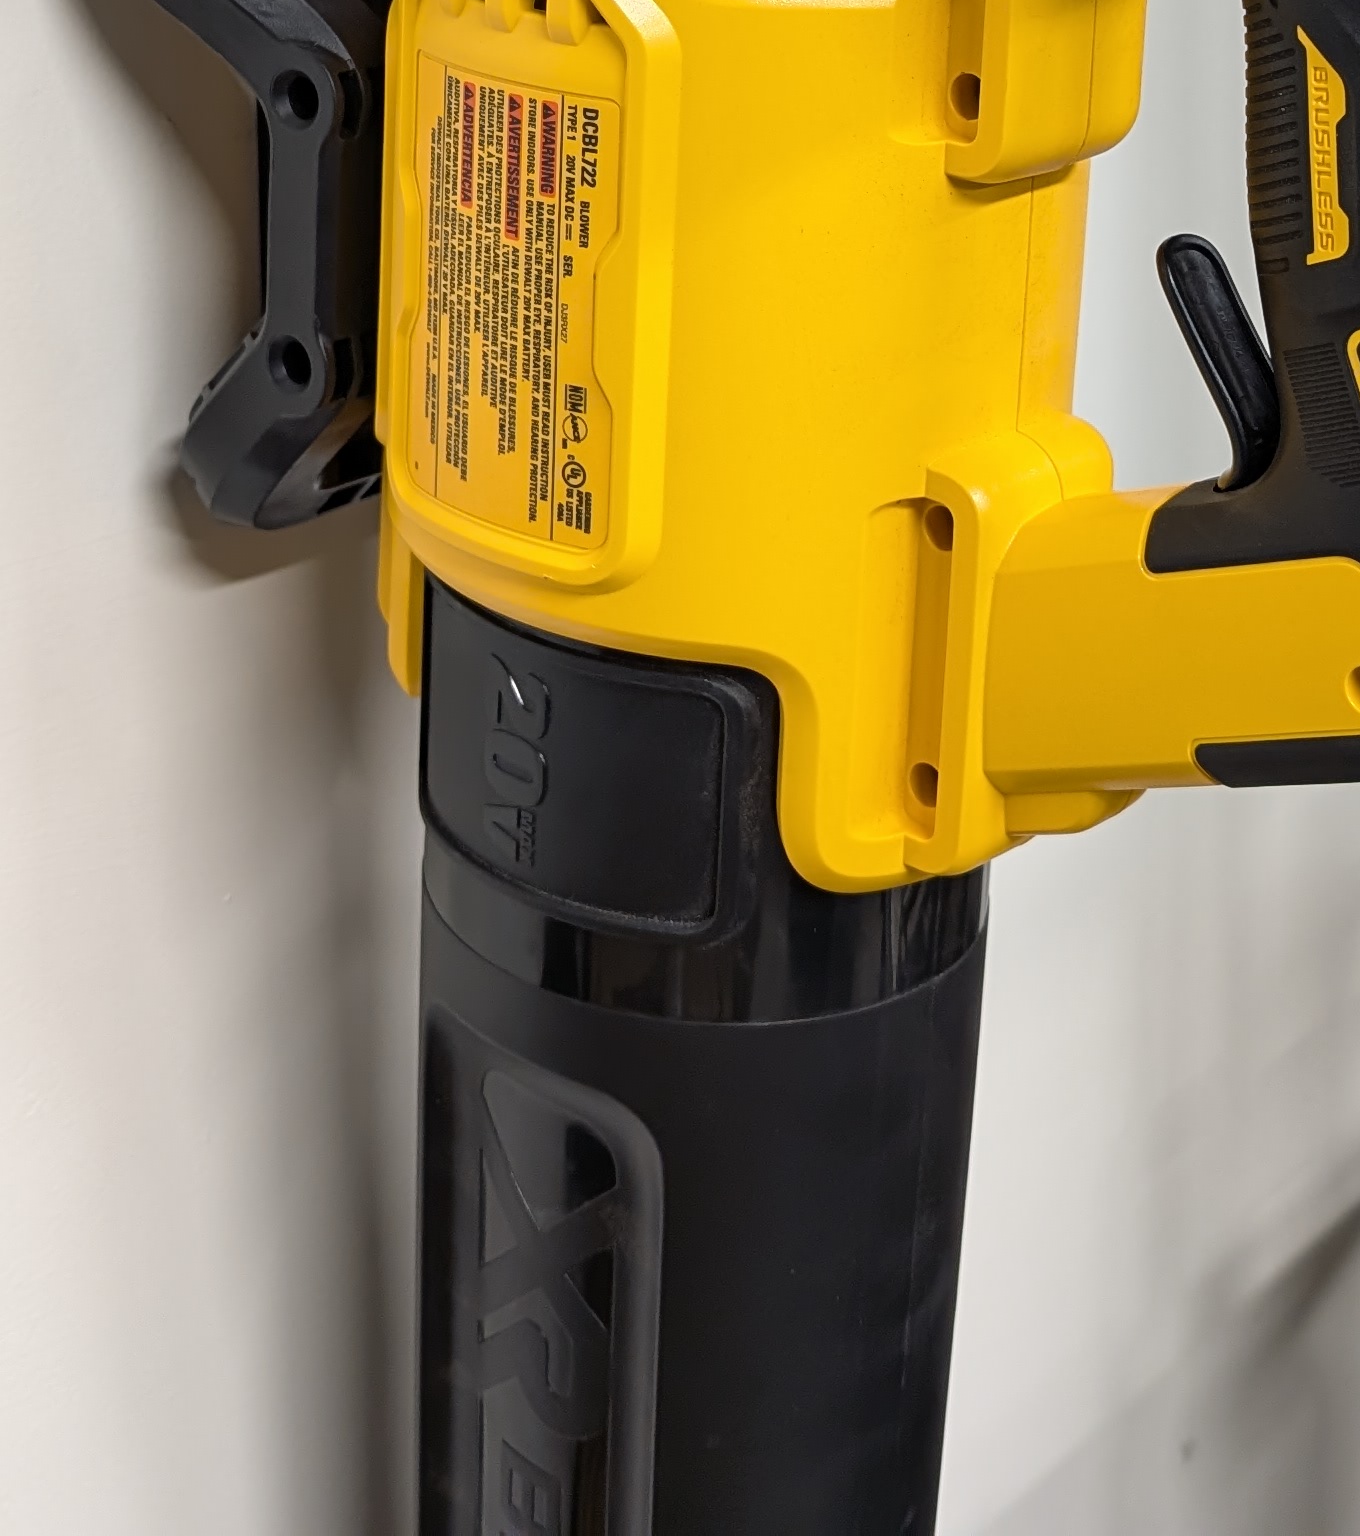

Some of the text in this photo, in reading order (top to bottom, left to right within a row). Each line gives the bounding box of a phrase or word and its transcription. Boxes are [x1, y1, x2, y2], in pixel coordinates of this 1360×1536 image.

[478, 86, 486, 153] UNIQUEMENT
[496, 89, 504, 133] UTILISER
[567, 105, 577, 133] TYPE
[461, 102, 474, 202] ADVERTENCIA
[541, 118, 556, 194] WARNING
[566, 154, 576, 175] 20V
[1313, 66, 1335, 253] BRUSHLESS
[485, 161, 493, 224] ENTREPOSER
[494, 156, 503, 224] PROTECTIONS
[506, 114, 521, 238] AVERTISSEMENT
[565, 177, 575, 204] MAX
[579, 107, 599, 248] DCBL722 BLOWER
[564, 205, 574, 221] DC
[511, 246, 519, 270] AFIN
[522, 98, 537, 382] STORE INDOORS. USE ONLY WITH DEWALT 20V MAX BATTERY.
[535, 248, 543, 267] USE
[475, 275, 481, 289] DE
[501, 244, 510, 314] L'UTILISATEUR
[511, 272, 519, 285] DE
[534, 268, 543, 305] PROPER
[457, 294, 463, 307] DE
[491, 278, 499, 348] RESPIRATOIRE
[510, 287, 521, 329] RÉDUIRE
[482, 299, 490, 341] UTILISER
[510, 330, 517, 342] LE
[464, 336, 470, 349] DE
[491, 349, 498, 362] ET
[500, 341, 508, 362] LIRE
[540, 204, 555, 501] TO REDUCE THE RISK OF INJURY, USER MUST READ INSTRUCTION
[500, 363, 507, 376] LE
[509, 343, 517, 380] RISQUE
[490, 362, 498, 409] AUDITIVE
[499, 377, 507, 406] MODE
[509, 381, 517, 395] DE
[568, 385, 583, 413] NOM
[462, 400, 469, 410] EL
[531, 396, 540, 417] AND
[530, 419, 539, 461] HEARING
[529, 463, 538, 523] PROTECTION.
